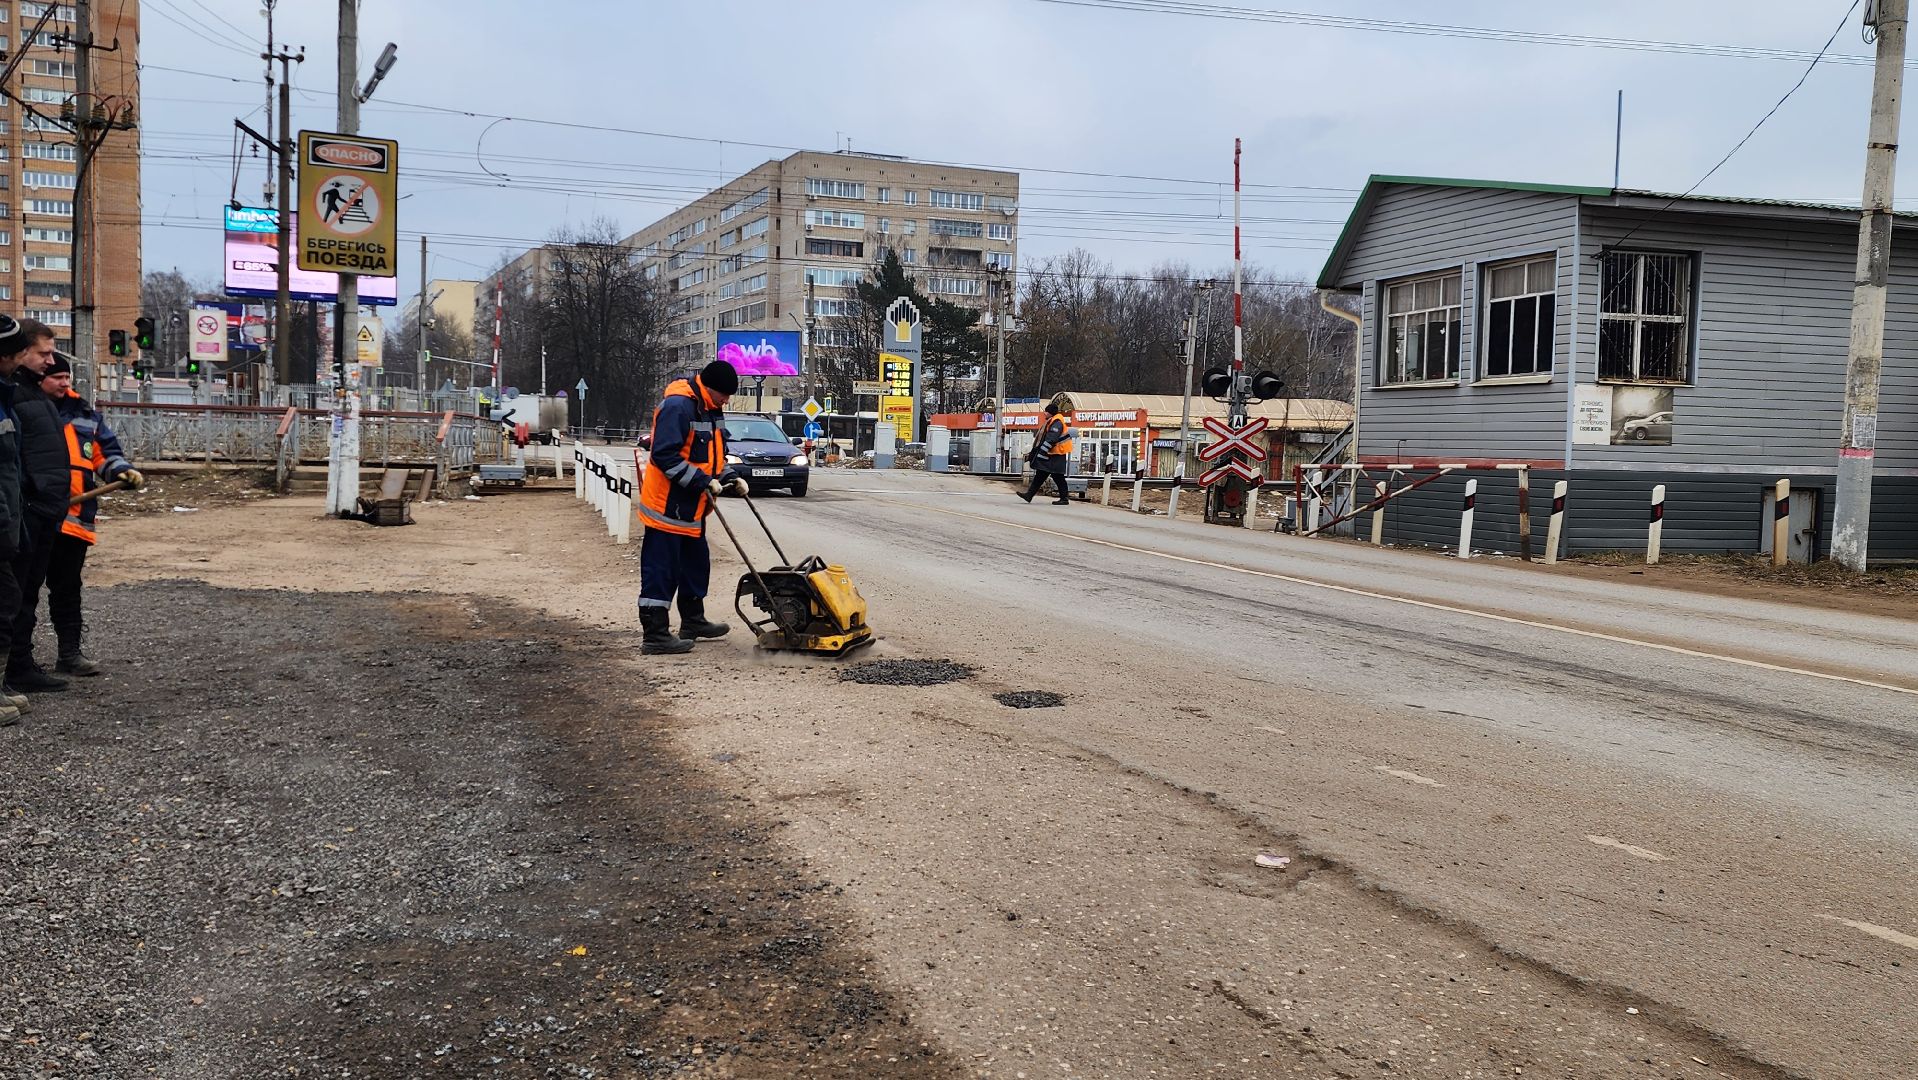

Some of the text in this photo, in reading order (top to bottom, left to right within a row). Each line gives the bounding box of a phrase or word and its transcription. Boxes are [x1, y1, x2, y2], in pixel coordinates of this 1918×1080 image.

[319, 147, 379, 163] ОПАСНО
[307, 238, 386, 254] БЕРЕГИСЬ
[306, 251, 387, 270] ПОЕЗДА
